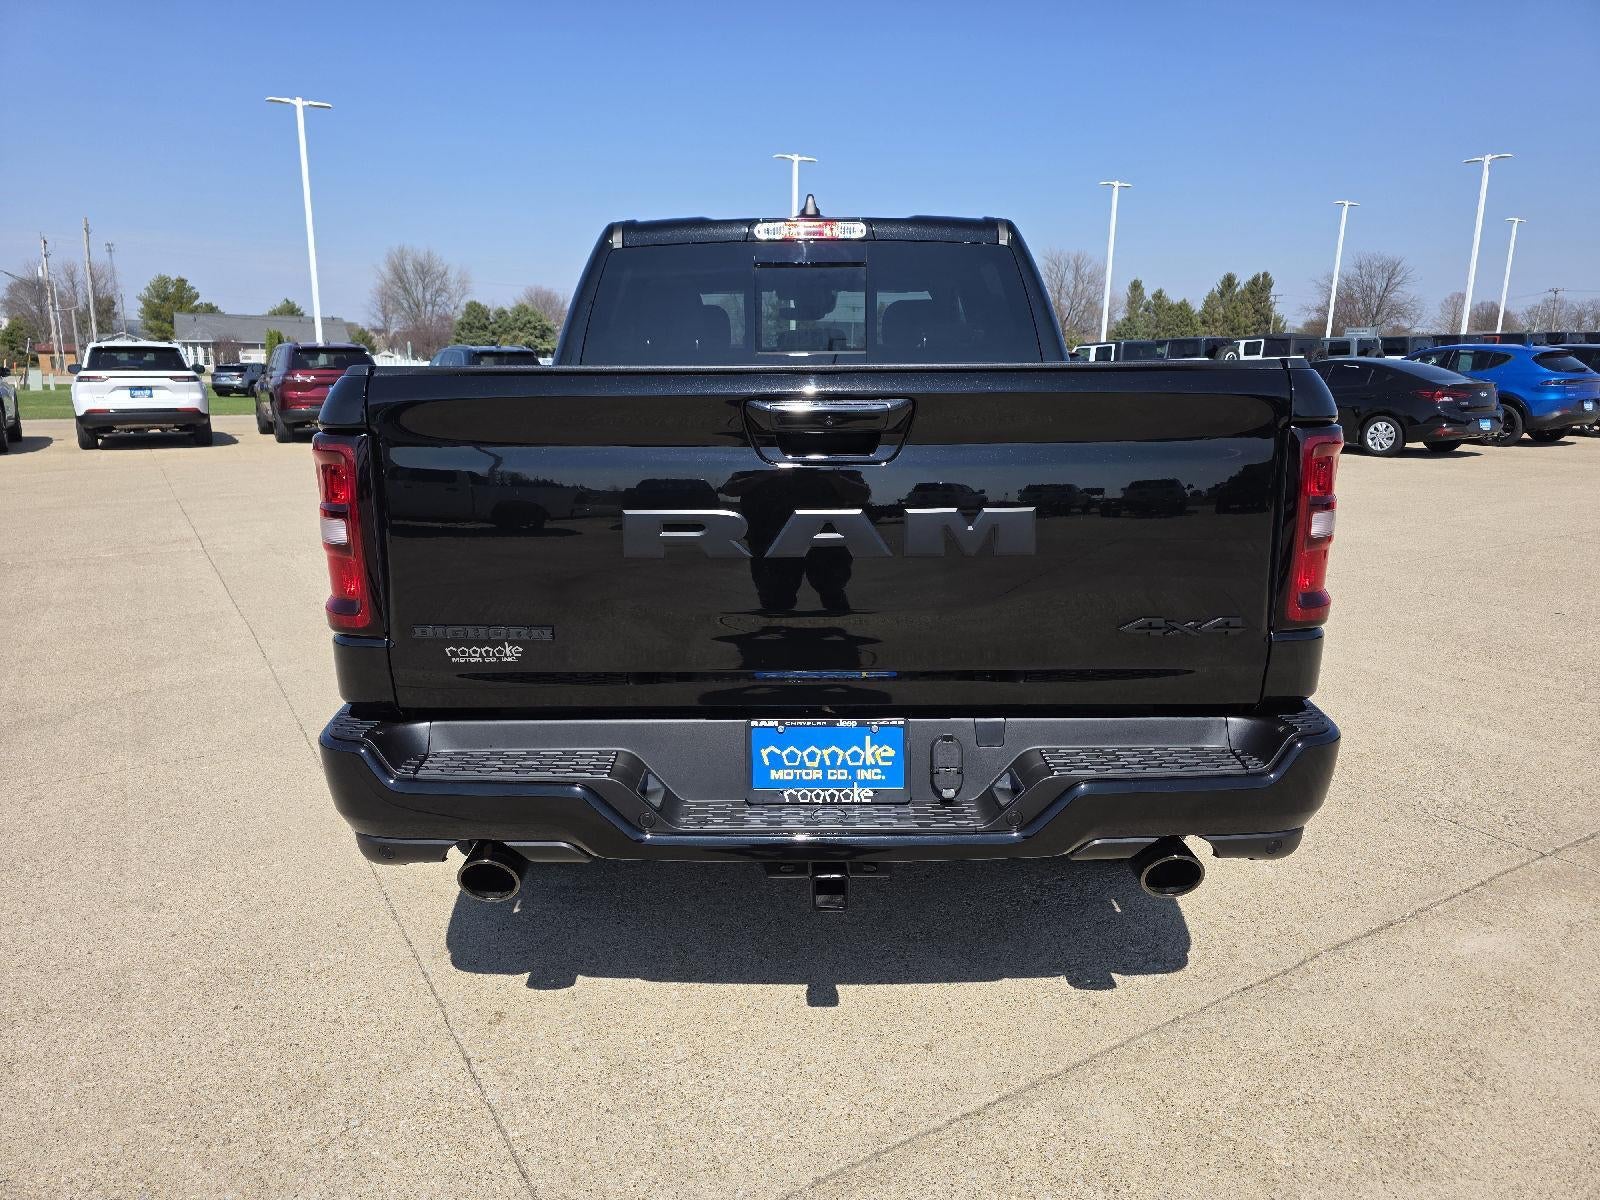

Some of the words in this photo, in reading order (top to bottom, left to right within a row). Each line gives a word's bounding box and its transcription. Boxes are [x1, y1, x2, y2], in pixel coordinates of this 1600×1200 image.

[622, 507, 1037, 558] RAM
[445, 641, 523, 657] roanoke
[836, 719, 858, 728] Jeep
[760, 735, 896, 767] roanoke
[770, 769, 823, 780] MOTOR
[857, 769, 886, 780] INC.
[783, 781, 874, 803] roanoke
